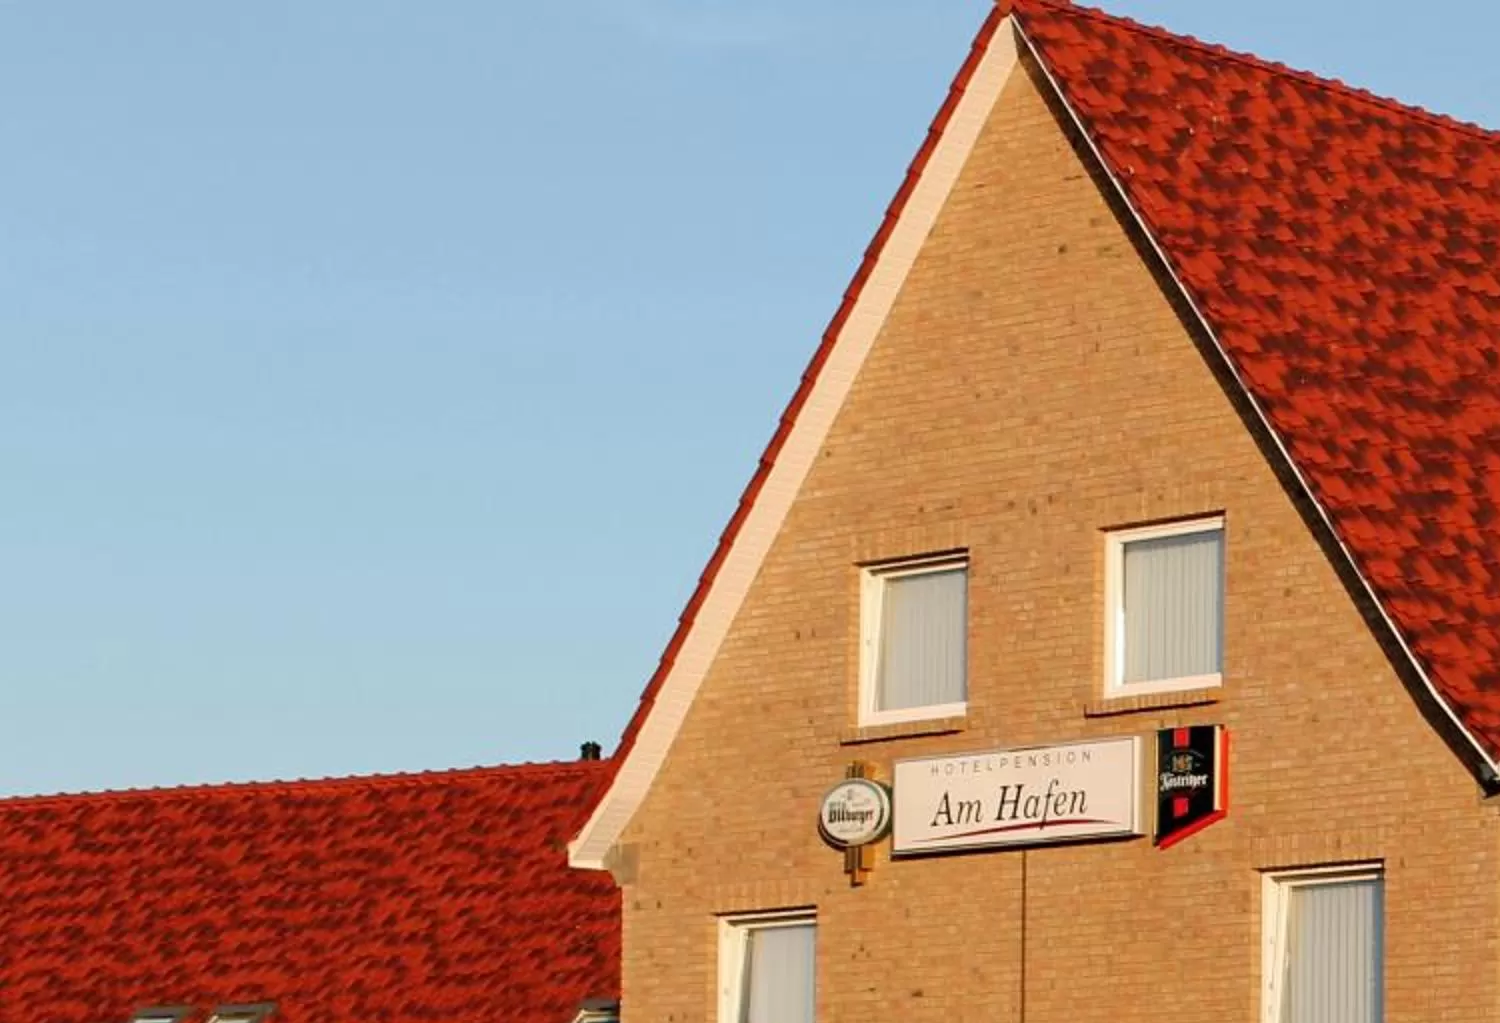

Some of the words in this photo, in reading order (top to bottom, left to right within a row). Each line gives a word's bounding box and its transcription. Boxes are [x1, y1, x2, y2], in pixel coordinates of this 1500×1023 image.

[930, 751, 1092, 776] HOTELPENSION
[930, 790, 984, 827] Am
[994, 778, 1089, 831] Hafen
